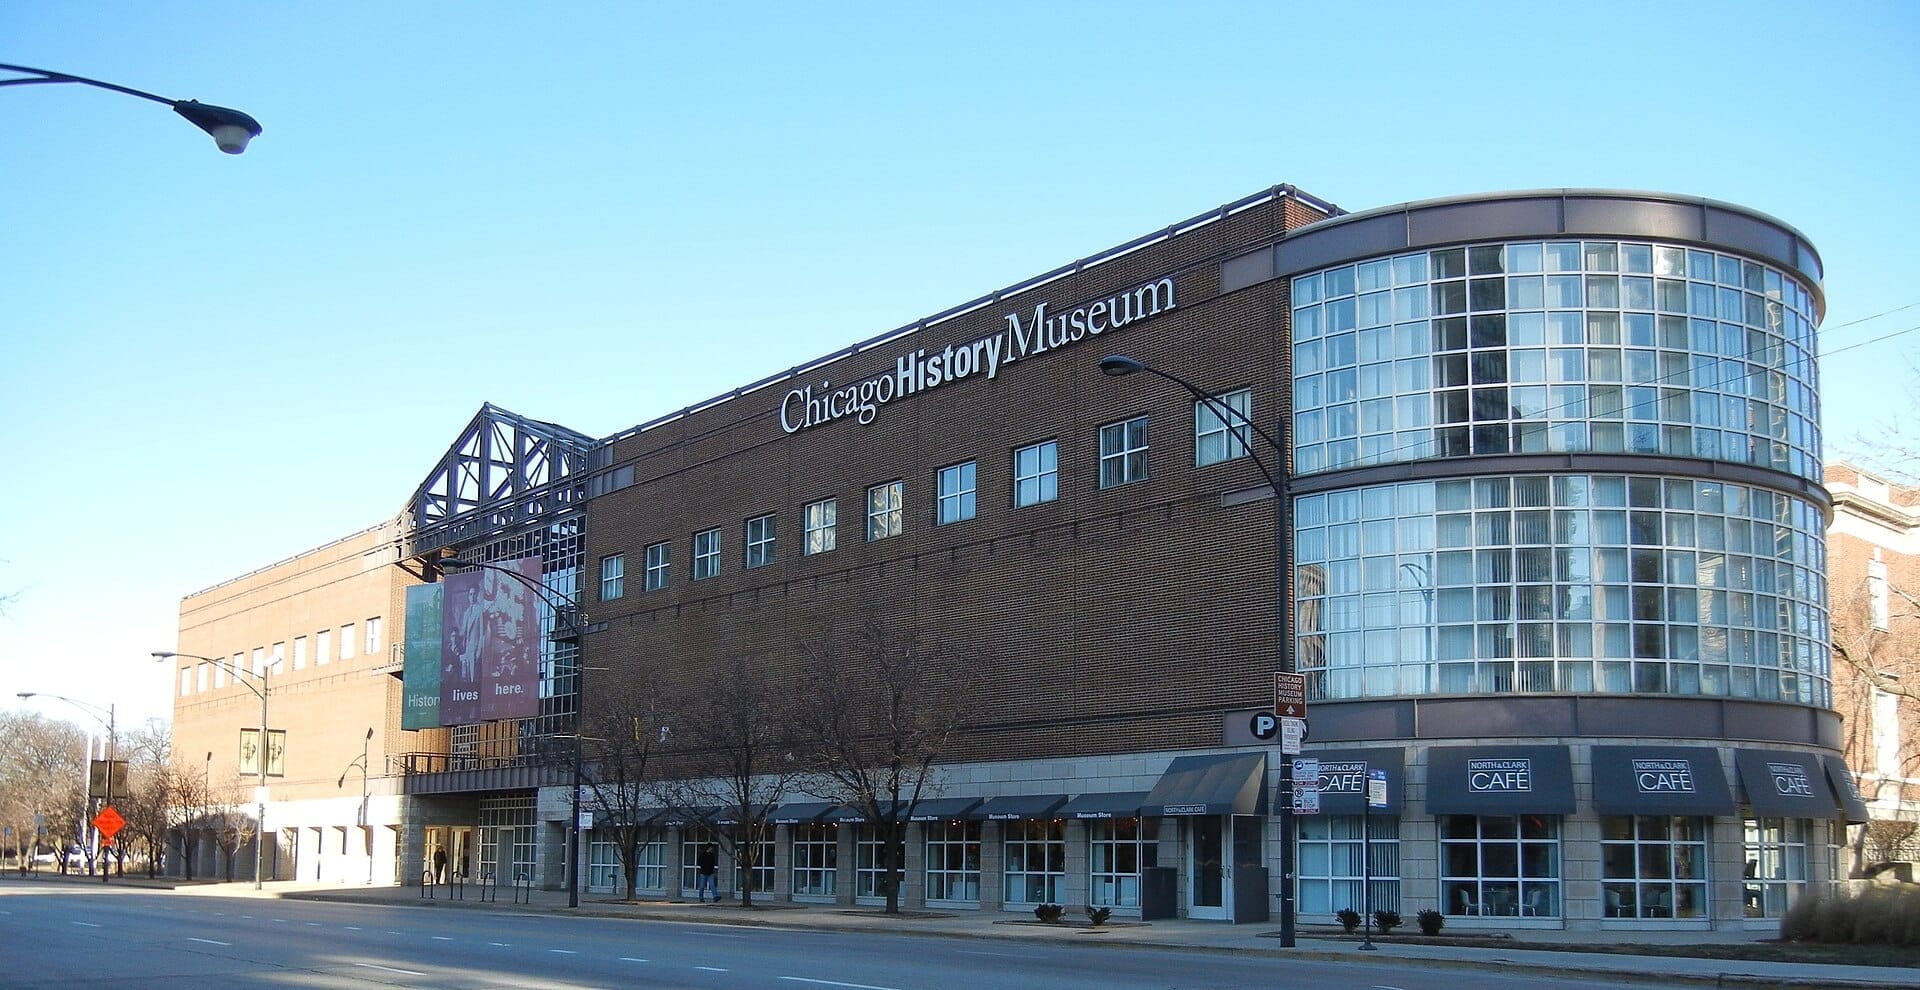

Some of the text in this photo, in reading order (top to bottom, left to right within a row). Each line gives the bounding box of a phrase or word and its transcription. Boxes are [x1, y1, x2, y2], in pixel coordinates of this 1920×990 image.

[780, 277, 1176, 434] Chicago History Museum
[1278, 675, 1302, 684] CHICAGO
[1278, 683, 1302, 691] HISTORY
[408, 683, 524, 707] Histor lives here.
[1278, 690, 1303, 698] MUSEUM
[1278, 696, 1303, 705] PARKING
[1257, 716, 1275, 736] P
[1471, 768, 1529, 790] CAFÉ
[1639, 769, 1693, 790] CAFÉ
